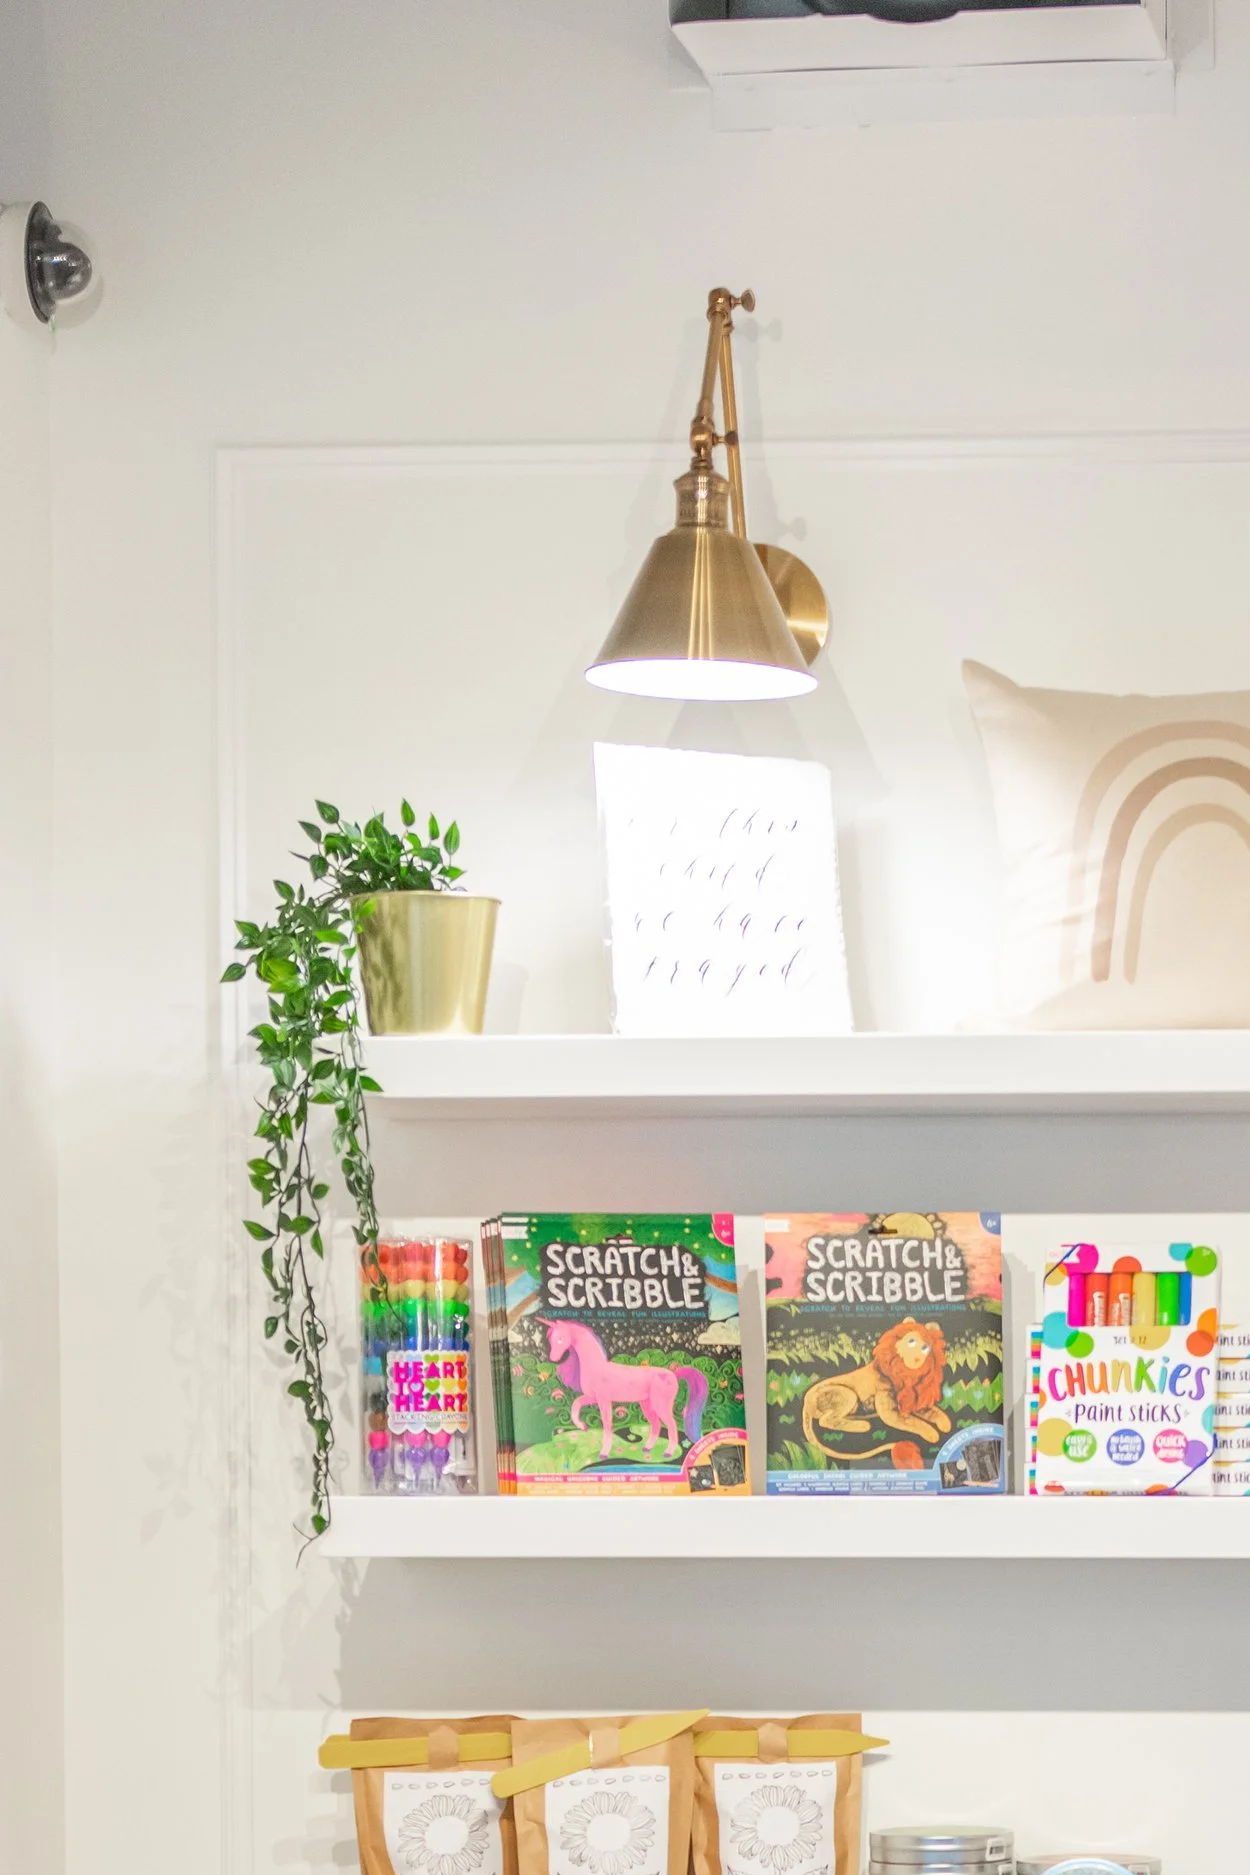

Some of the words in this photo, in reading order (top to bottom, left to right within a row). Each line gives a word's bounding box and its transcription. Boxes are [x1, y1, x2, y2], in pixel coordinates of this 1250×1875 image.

[547, 1277, 705, 1309] SCRIBBLE
[806, 1270, 965, 1303] SCRIBBLE
[393, 1361, 465, 1380] HEART
[394, 1394, 468, 1412] HEART
